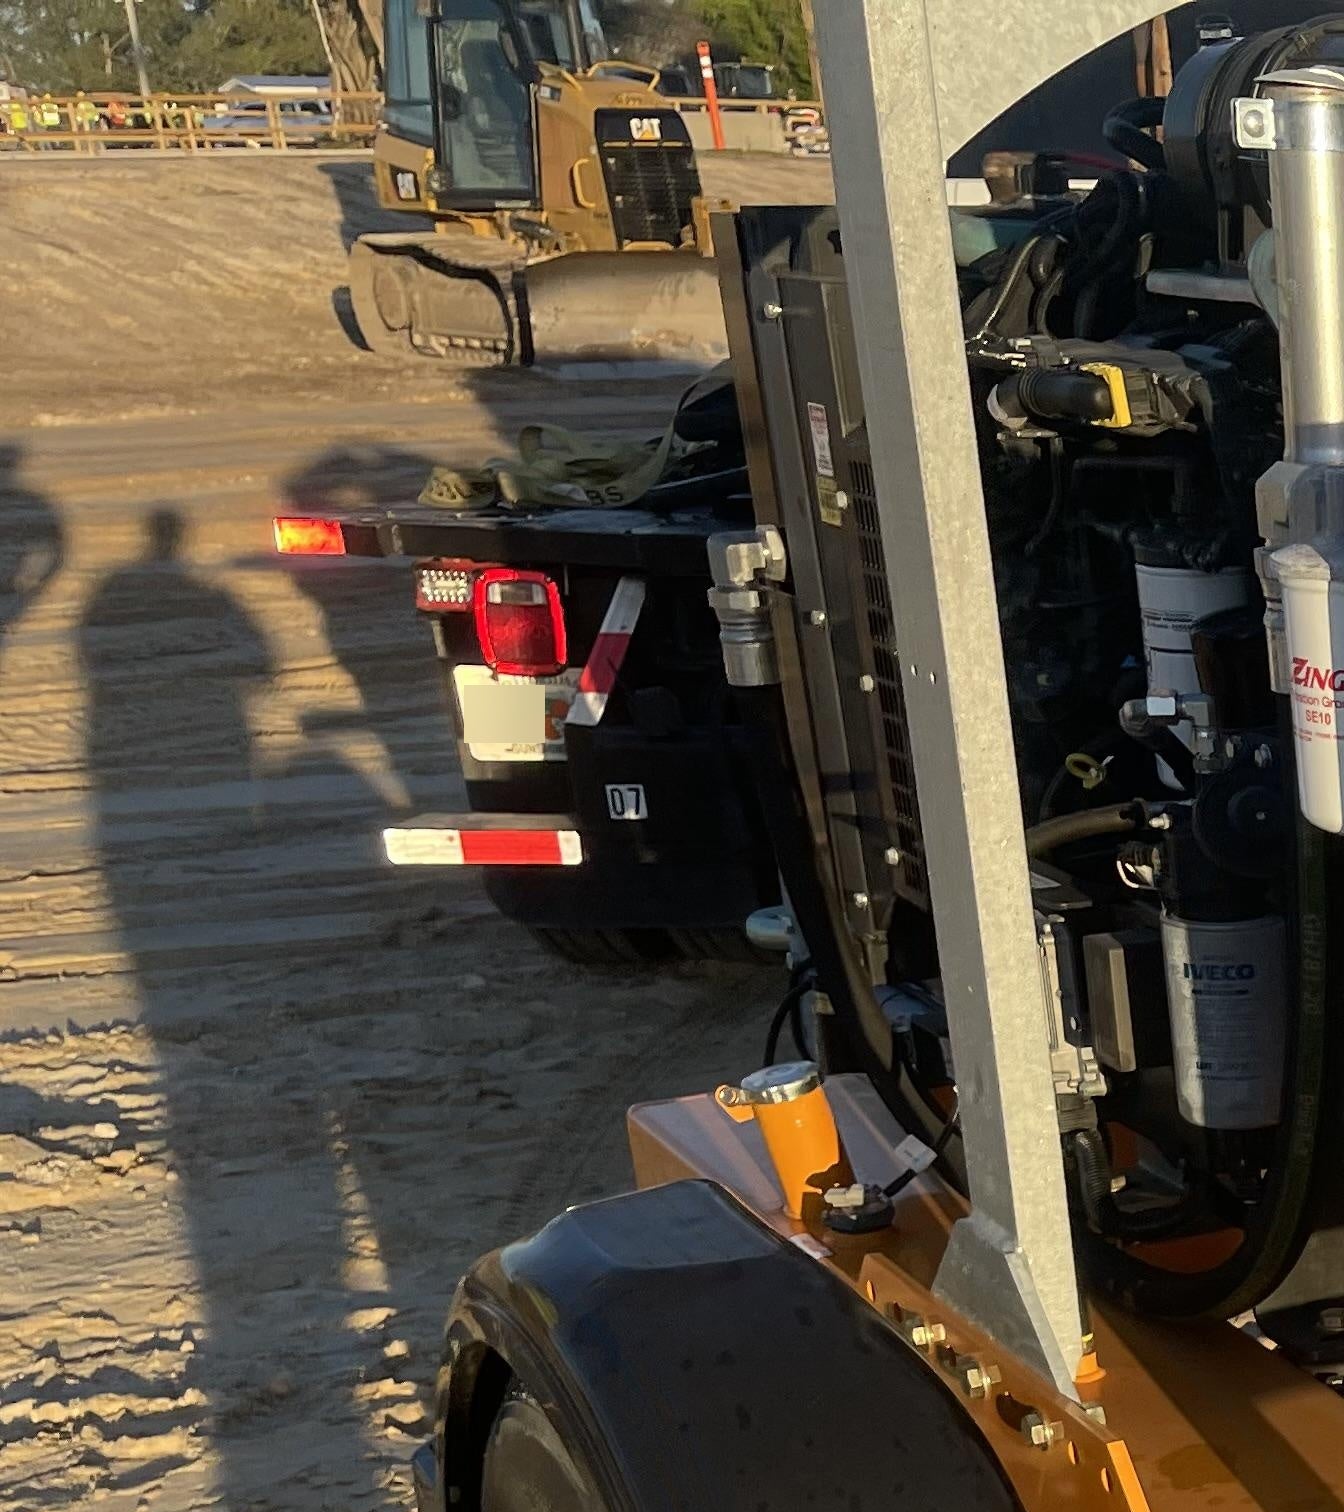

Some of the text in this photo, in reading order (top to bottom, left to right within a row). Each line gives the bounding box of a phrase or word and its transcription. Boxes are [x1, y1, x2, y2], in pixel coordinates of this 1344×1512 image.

[629, 117, 661, 141] CAT
[1305, 709, 1332, 725] SE10
[609, 787, 641, 816] 07
[1183, 962, 1255, 981] IVECO
